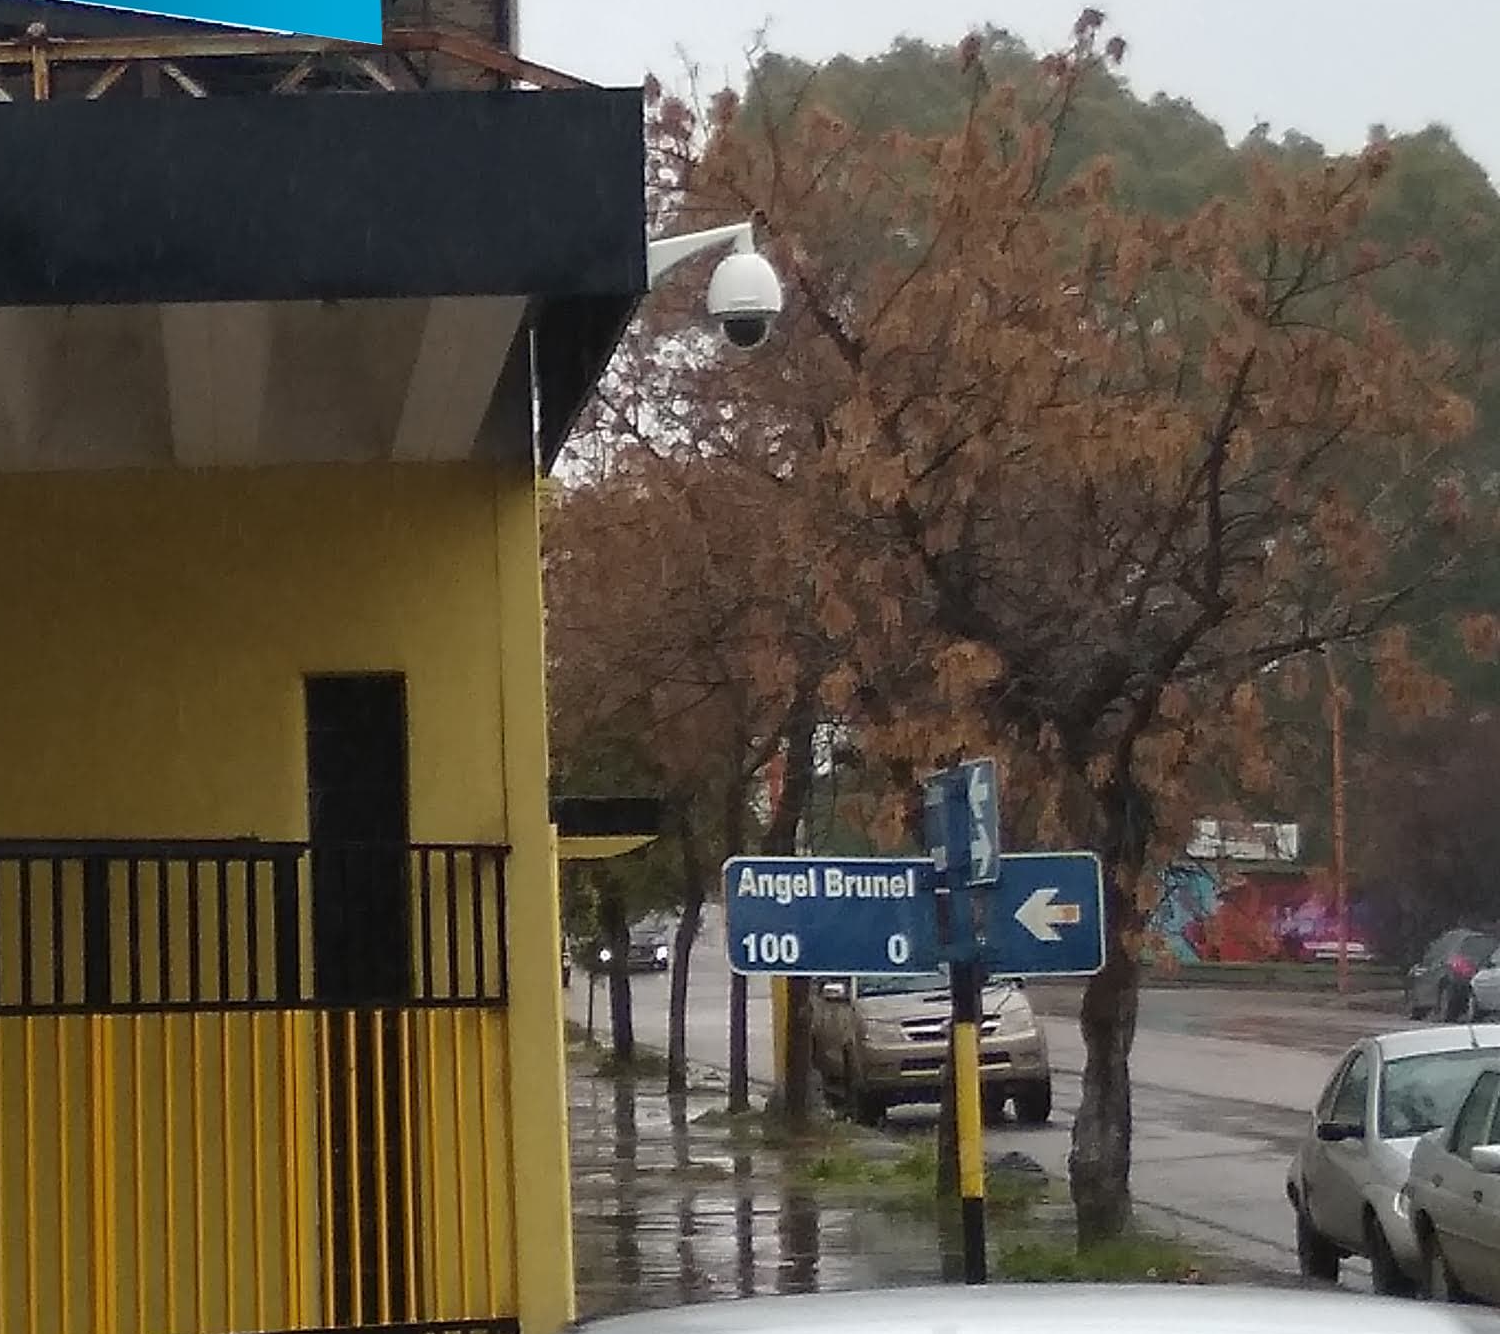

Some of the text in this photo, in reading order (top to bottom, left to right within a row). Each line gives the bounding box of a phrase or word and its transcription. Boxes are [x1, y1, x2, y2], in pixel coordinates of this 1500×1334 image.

[737, 867, 915, 905] Angel Brunel
[741, 932, 910, 965] 100 0
